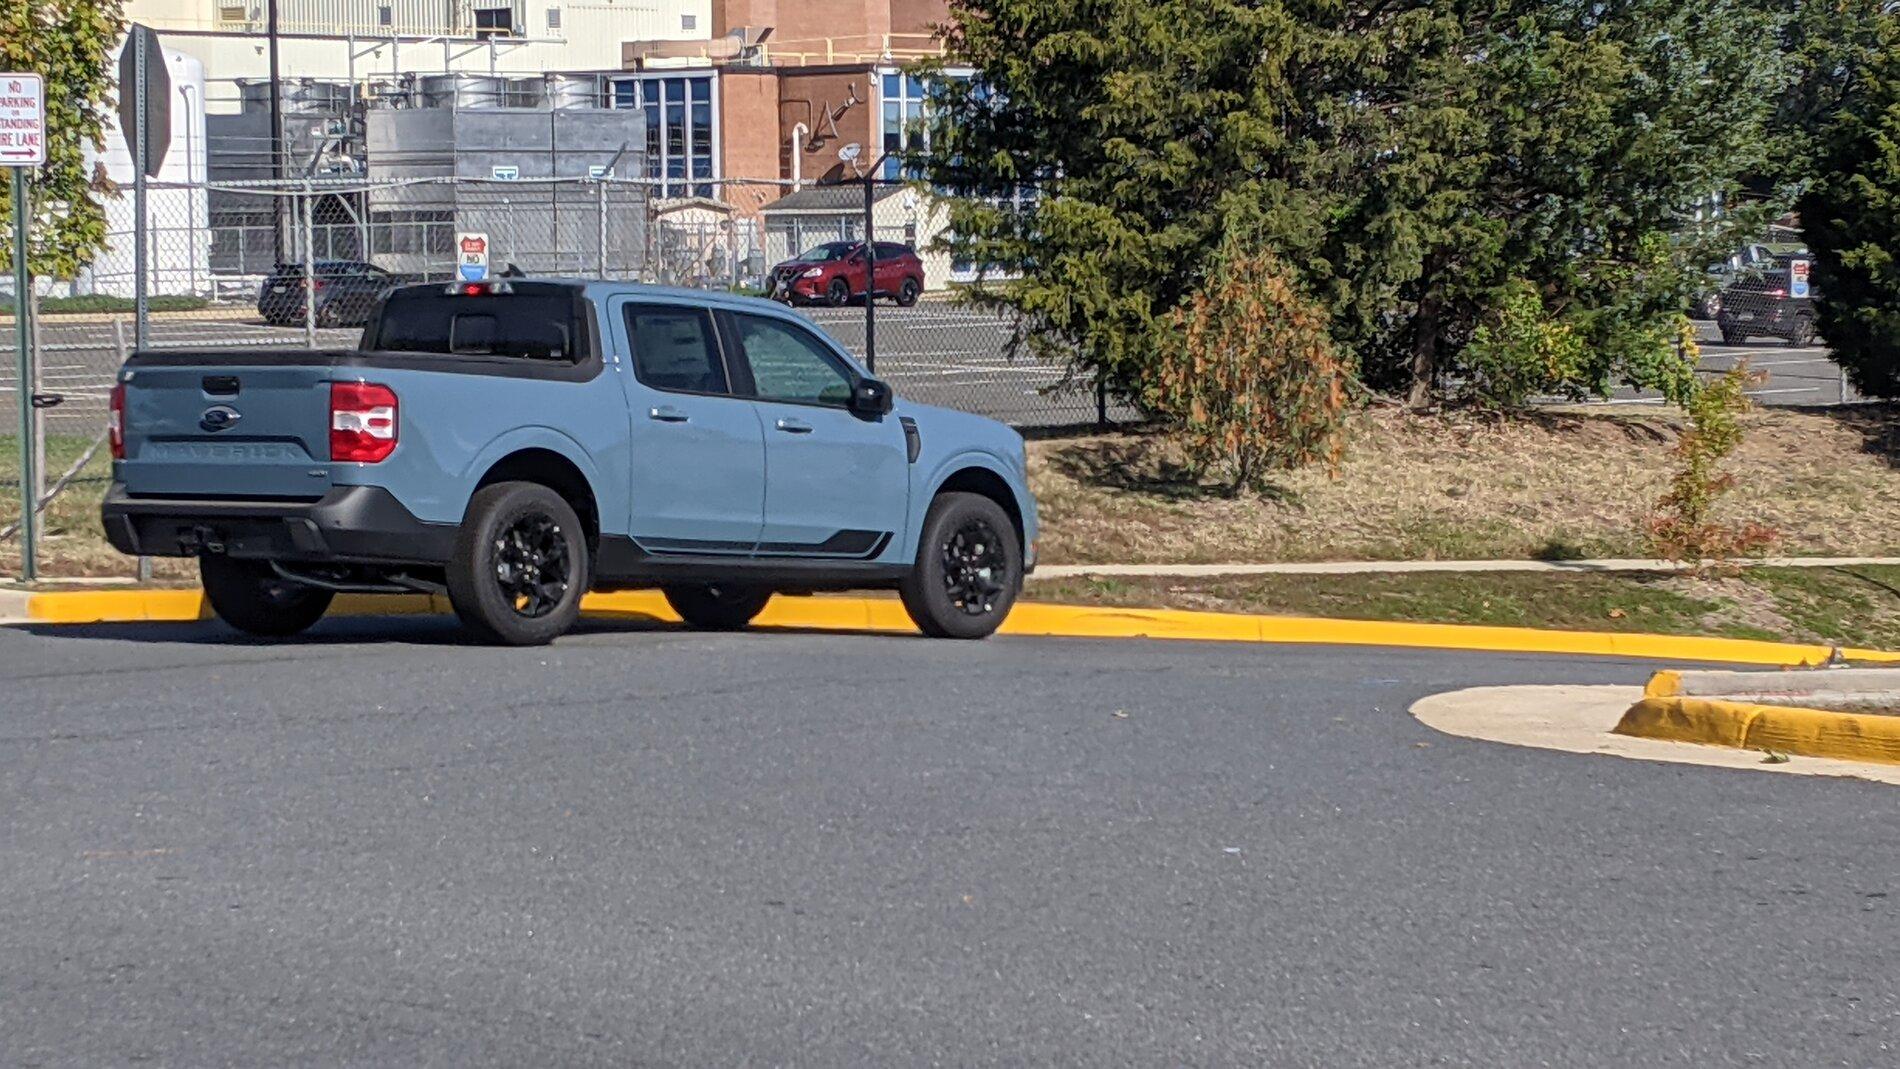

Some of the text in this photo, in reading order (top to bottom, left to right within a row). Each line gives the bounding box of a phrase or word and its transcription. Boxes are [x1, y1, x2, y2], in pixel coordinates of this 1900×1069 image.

[8, 80, 21, 93] NO
[0, 119, 39, 129] TANDING
[16, 133, 40, 146] LANE
